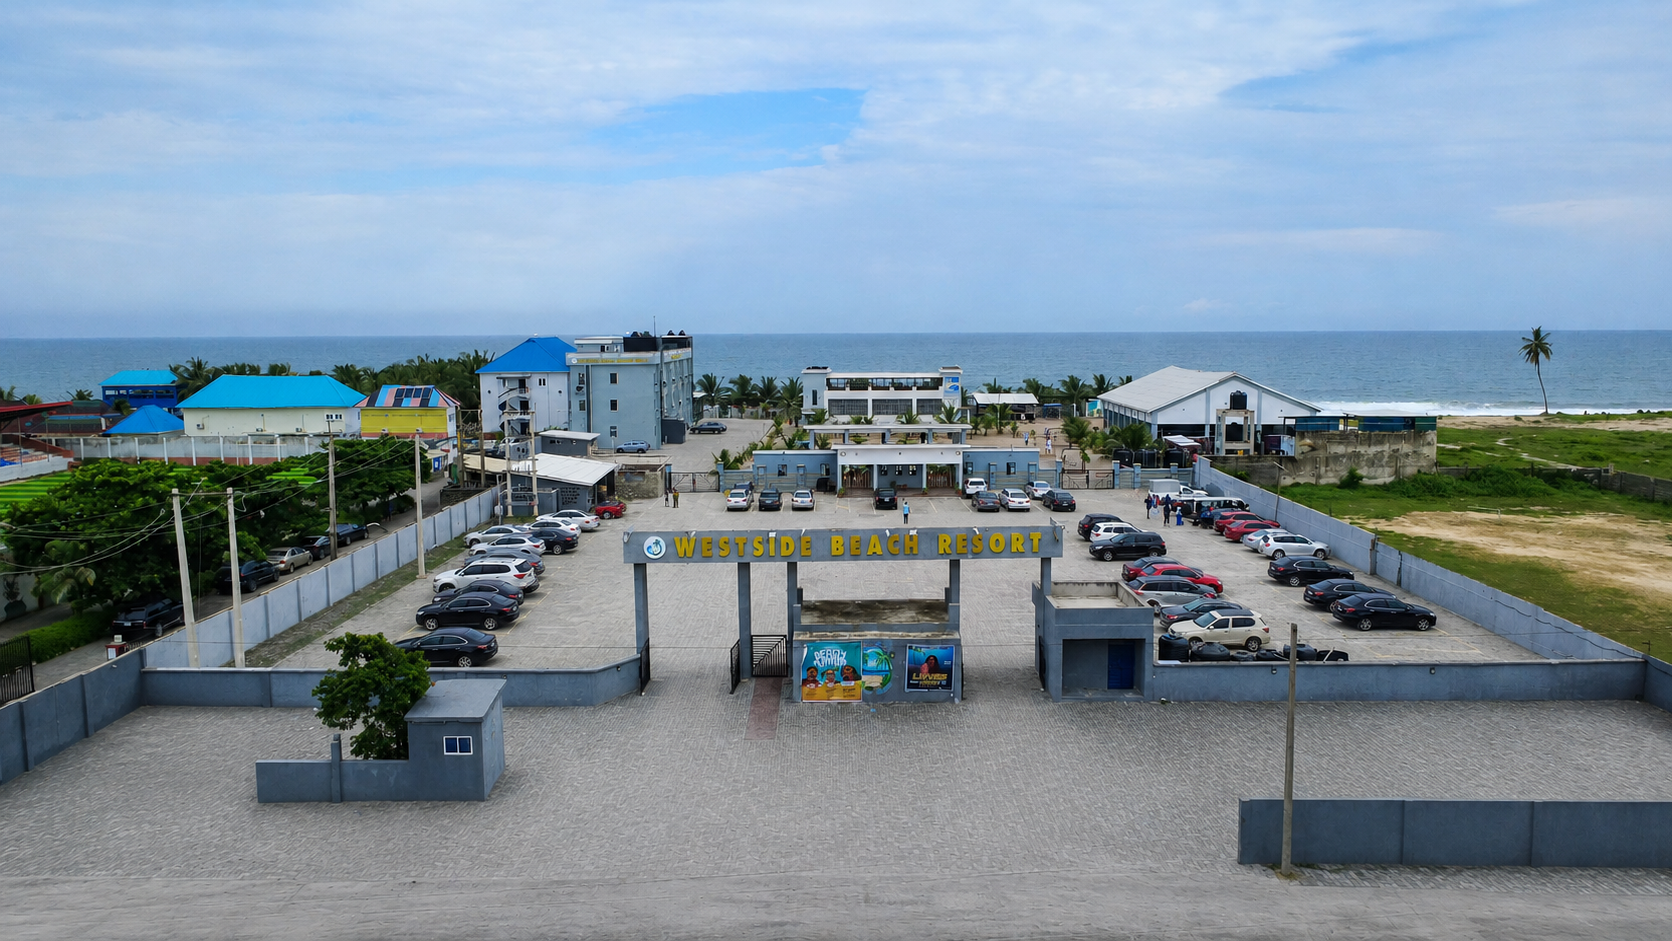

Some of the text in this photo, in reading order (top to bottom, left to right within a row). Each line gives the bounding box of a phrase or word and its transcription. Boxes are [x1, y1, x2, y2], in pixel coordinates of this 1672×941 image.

[674, 532, 1042, 558] WESTSIDE BEACH RESORT
